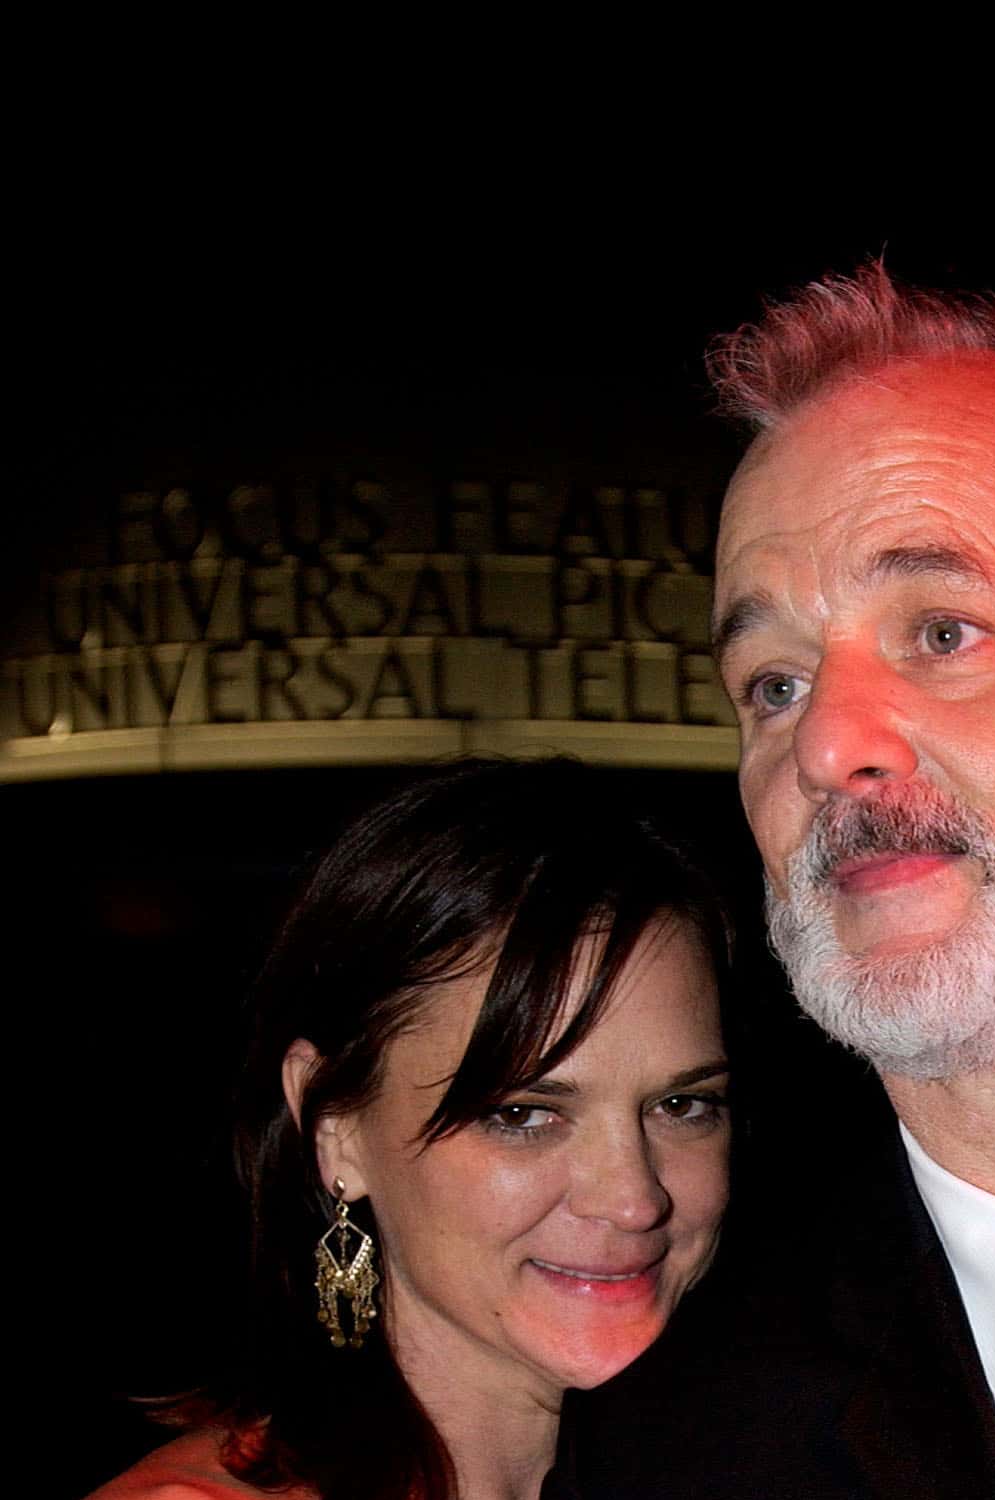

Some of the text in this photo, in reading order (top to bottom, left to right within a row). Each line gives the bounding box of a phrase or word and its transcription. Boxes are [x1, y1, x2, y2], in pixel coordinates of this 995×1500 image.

[112, 482, 390, 561] FOCUS
[48, 554, 512, 647] UNIVERSAL
[16, 638, 474, 736] UNIVERSAL
